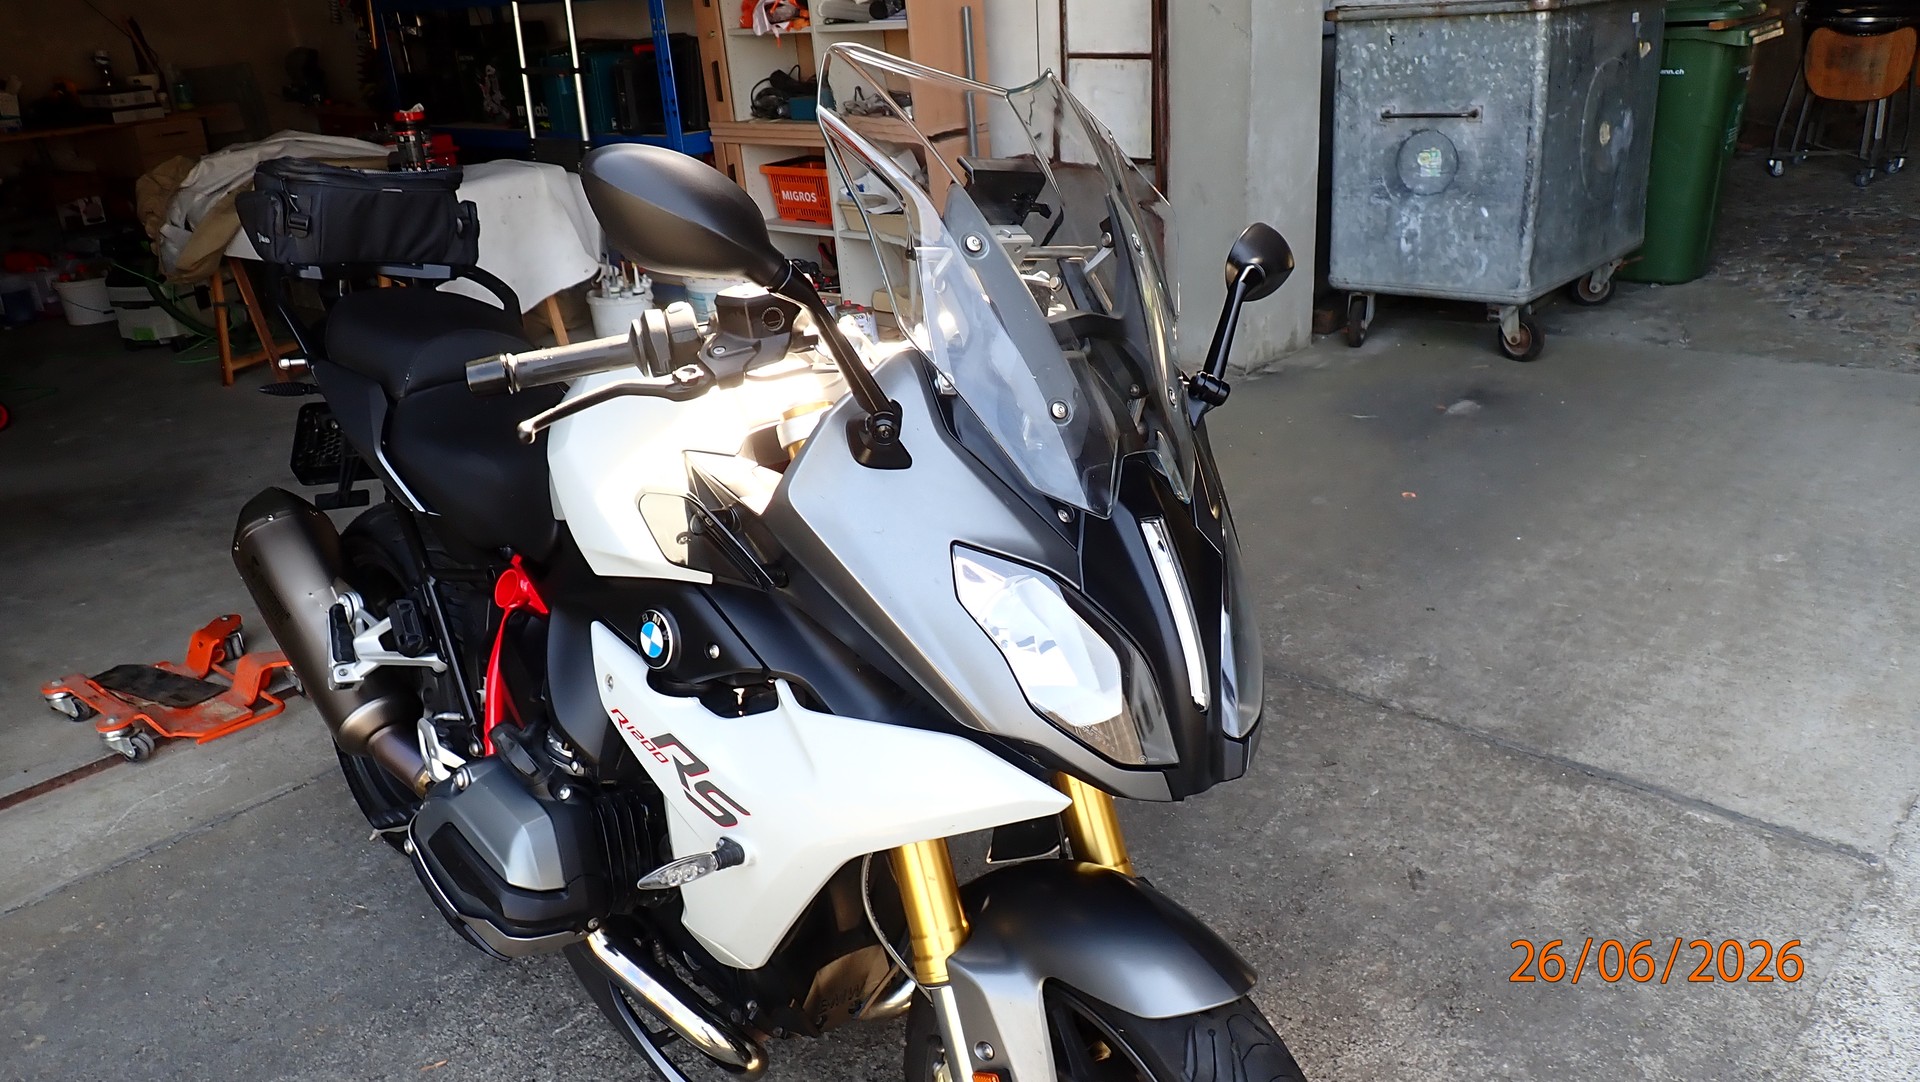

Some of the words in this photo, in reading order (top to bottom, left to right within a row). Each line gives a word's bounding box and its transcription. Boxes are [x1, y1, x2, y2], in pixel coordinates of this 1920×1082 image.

[781, 190, 818, 203] MIGROS
[641, 613, 669, 641] BMW
[611, 709, 669, 763] R1200
[650, 732, 751, 827] RS
